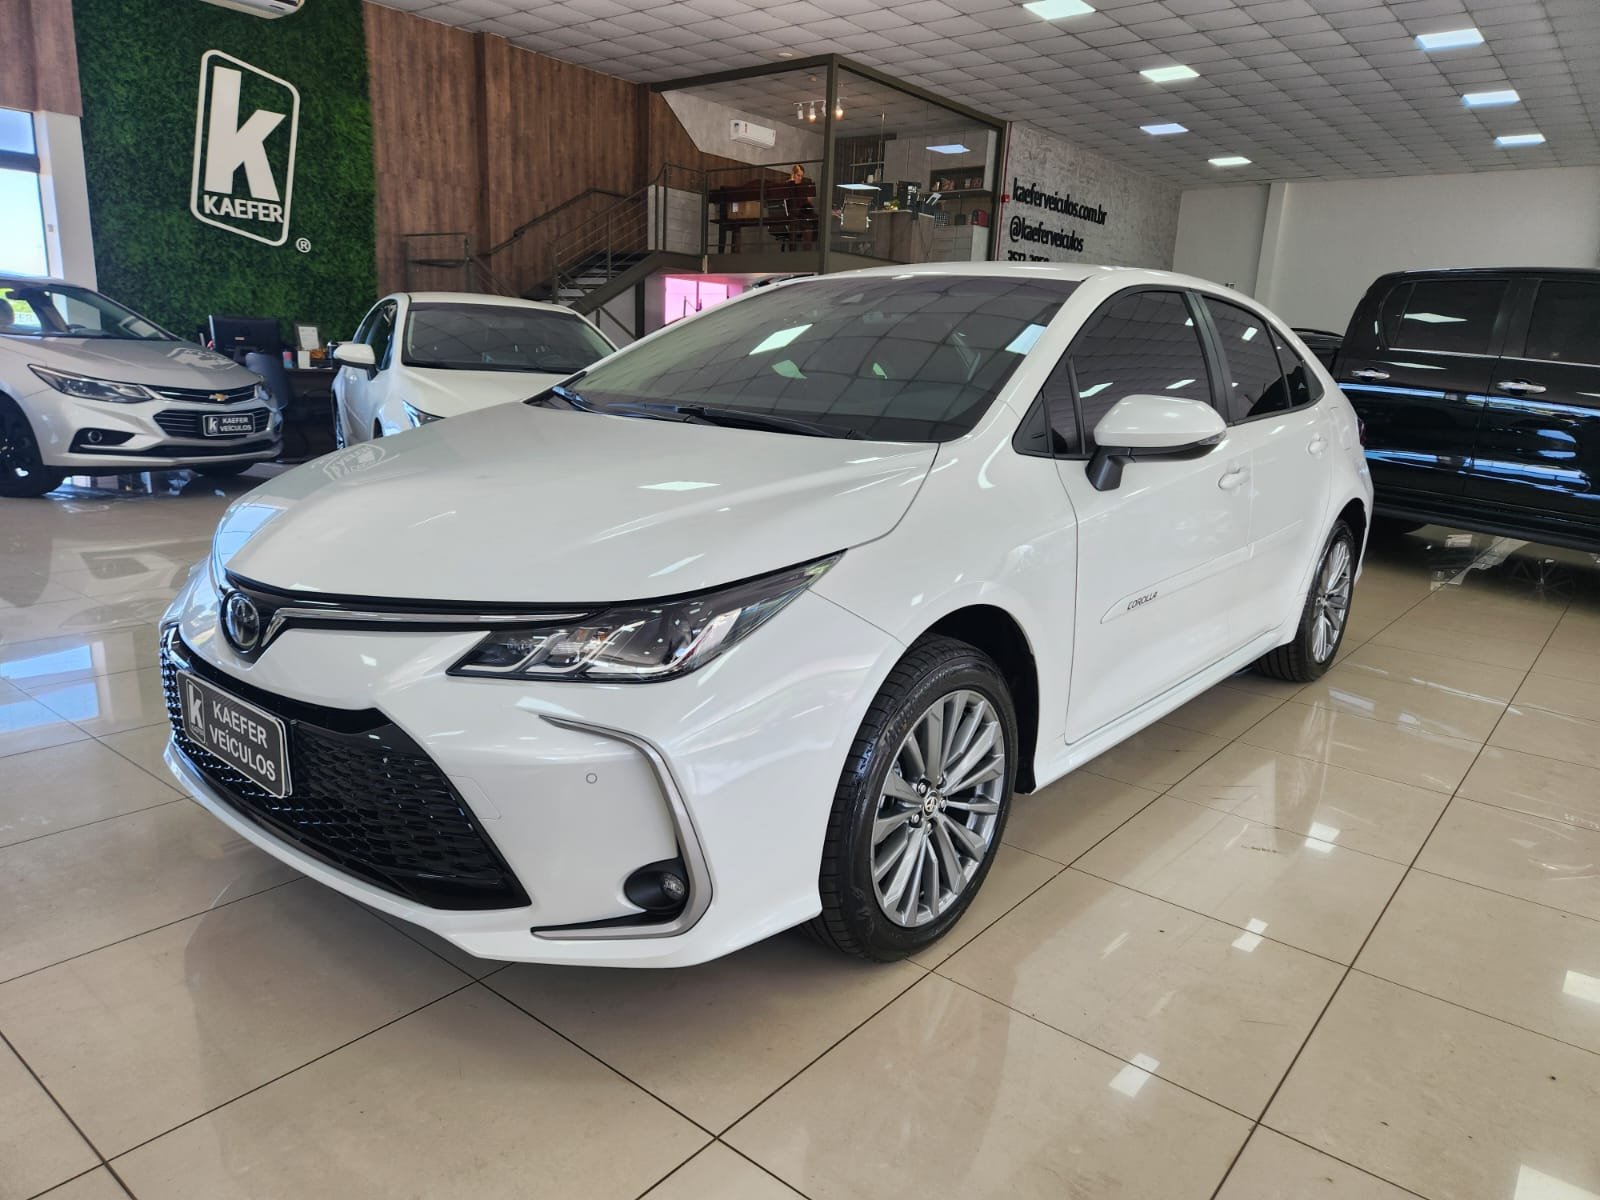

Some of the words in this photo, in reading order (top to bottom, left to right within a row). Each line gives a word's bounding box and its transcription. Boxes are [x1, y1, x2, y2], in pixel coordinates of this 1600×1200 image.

[203, 194, 284, 223] KAEFER
[1013, 177, 1108, 225] kaeferveiculos.com.br
[1010, 215, 1084, 253] @kaeferveiculos
[212, 700, 268, 749] KAEFER
